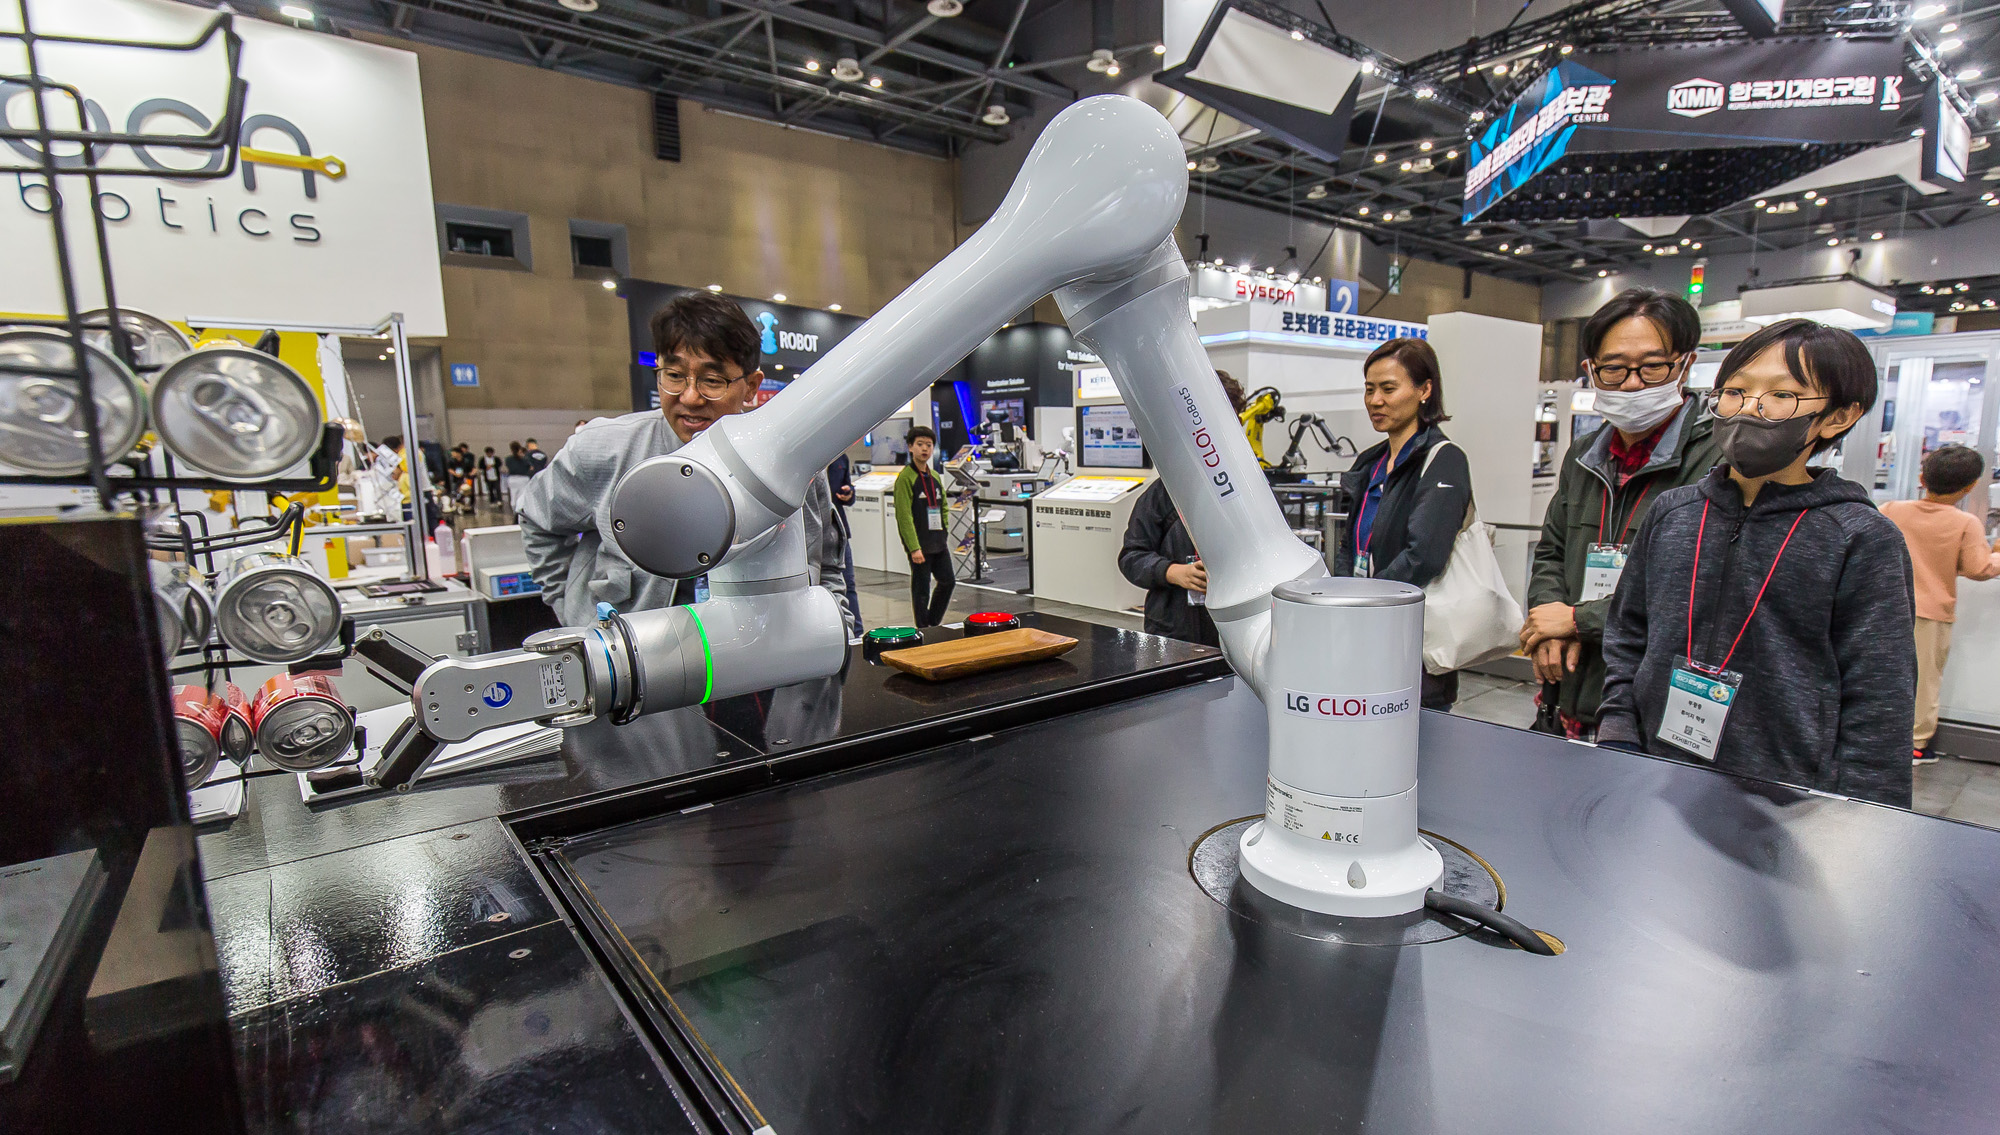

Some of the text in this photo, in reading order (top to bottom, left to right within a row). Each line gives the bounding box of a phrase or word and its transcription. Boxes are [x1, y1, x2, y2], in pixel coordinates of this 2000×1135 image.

[1667, 86, 1725, 109] KIMM
[1728, 76, 1877, 102] 한국기계연구원
[1572, 112, 1610, 123] CENTER
[1236, 279, 1295, 302] Syscon
[1282, 311, 1330, 336] 로봇활용
[779, 330, 819, 353] ROBOT
[1178, 387, 1235, 498] LG CLOi CoBot5
[1287, 692, 1410, 716] LG CLOi CoBot5
[1671, 733, 1701, 751] EXHIBITOR
